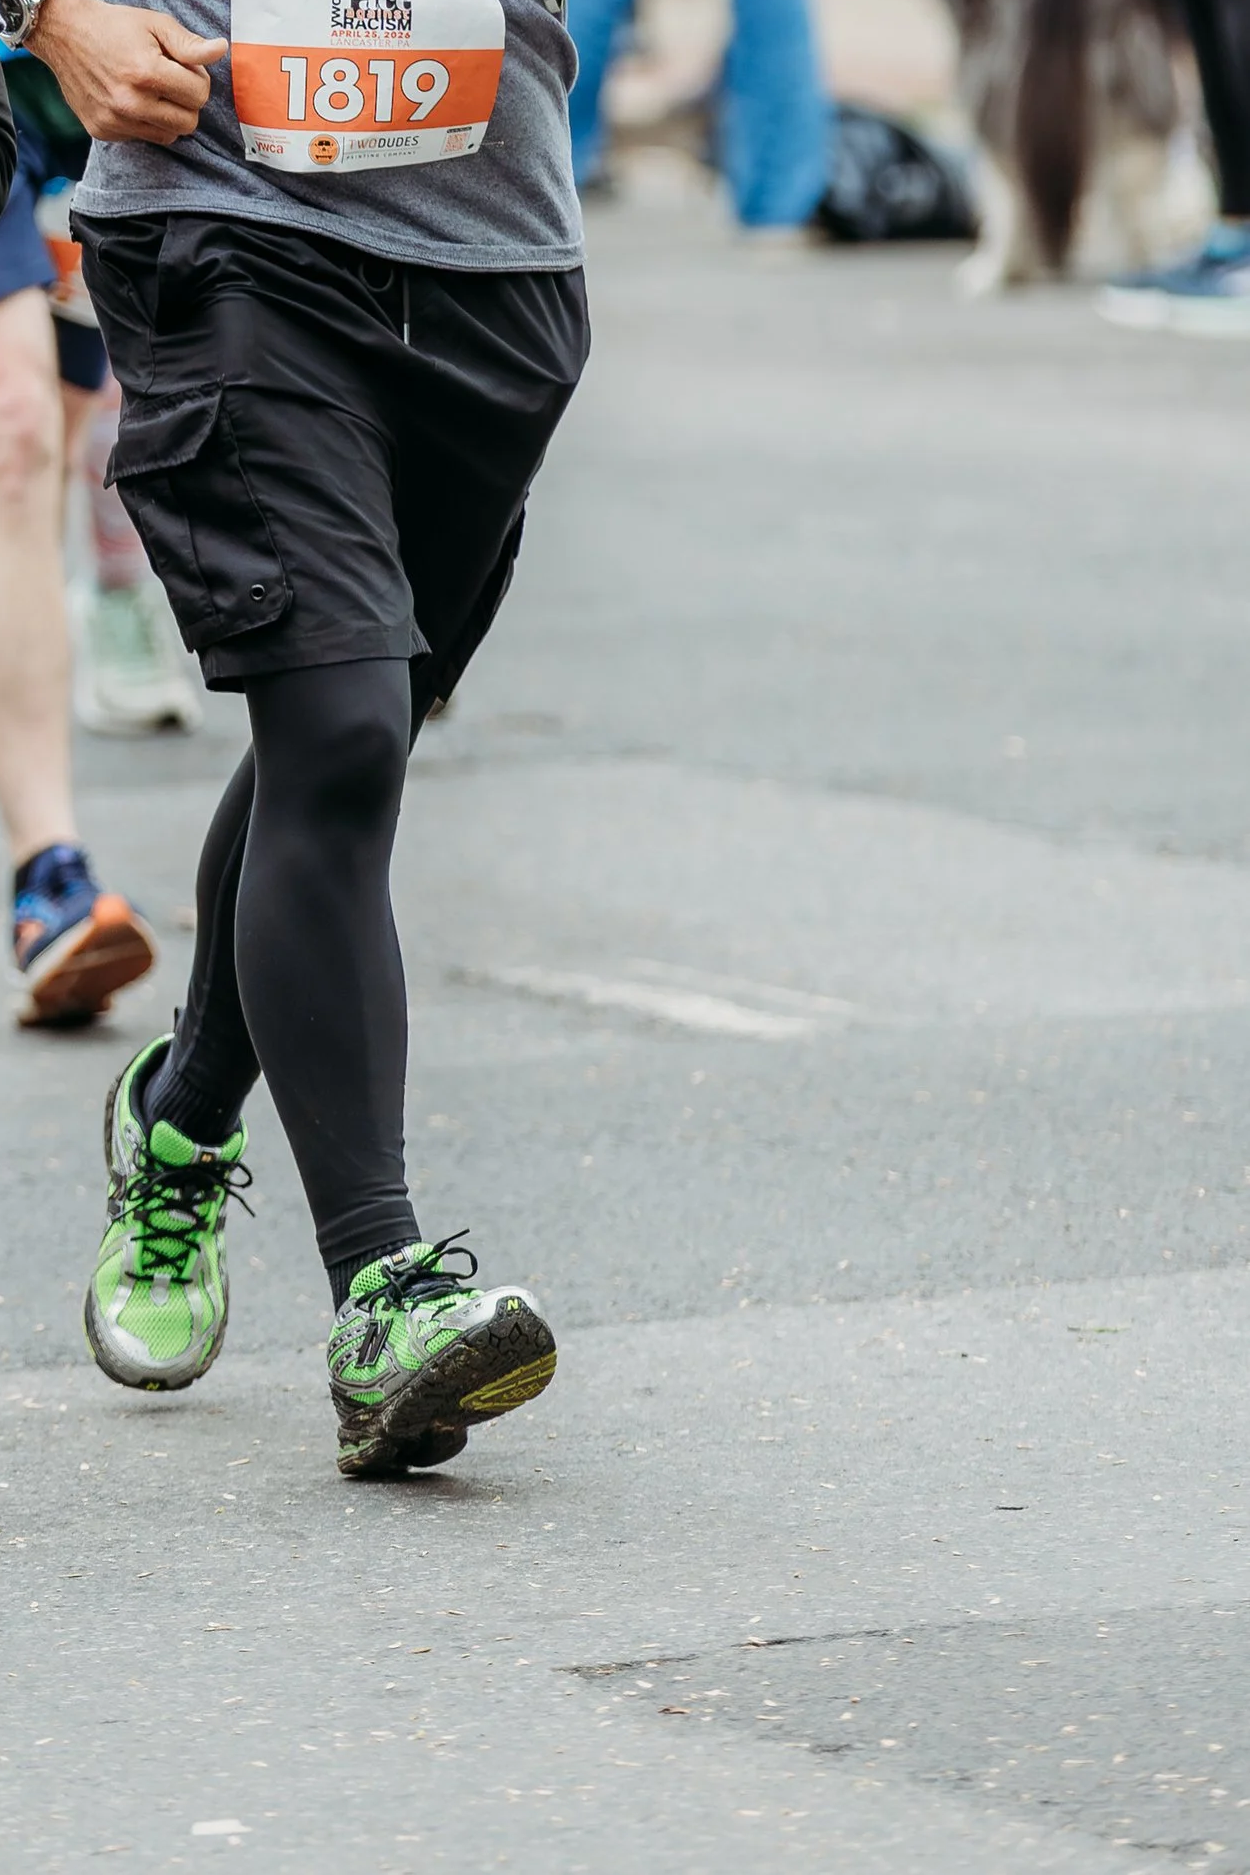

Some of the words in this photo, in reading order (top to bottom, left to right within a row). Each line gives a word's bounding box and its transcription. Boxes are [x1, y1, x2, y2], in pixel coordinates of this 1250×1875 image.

[345, 7, 410, 21] against
[343, 14, 412, 31] RACISM
[331, 30, 362, 38] APRIL
[384, 31, 411, 39] 2026
[397, 39, 410, 47] PA
[280, 55, 450, 124] 1819
[254, 140, 284, 155] ywca
